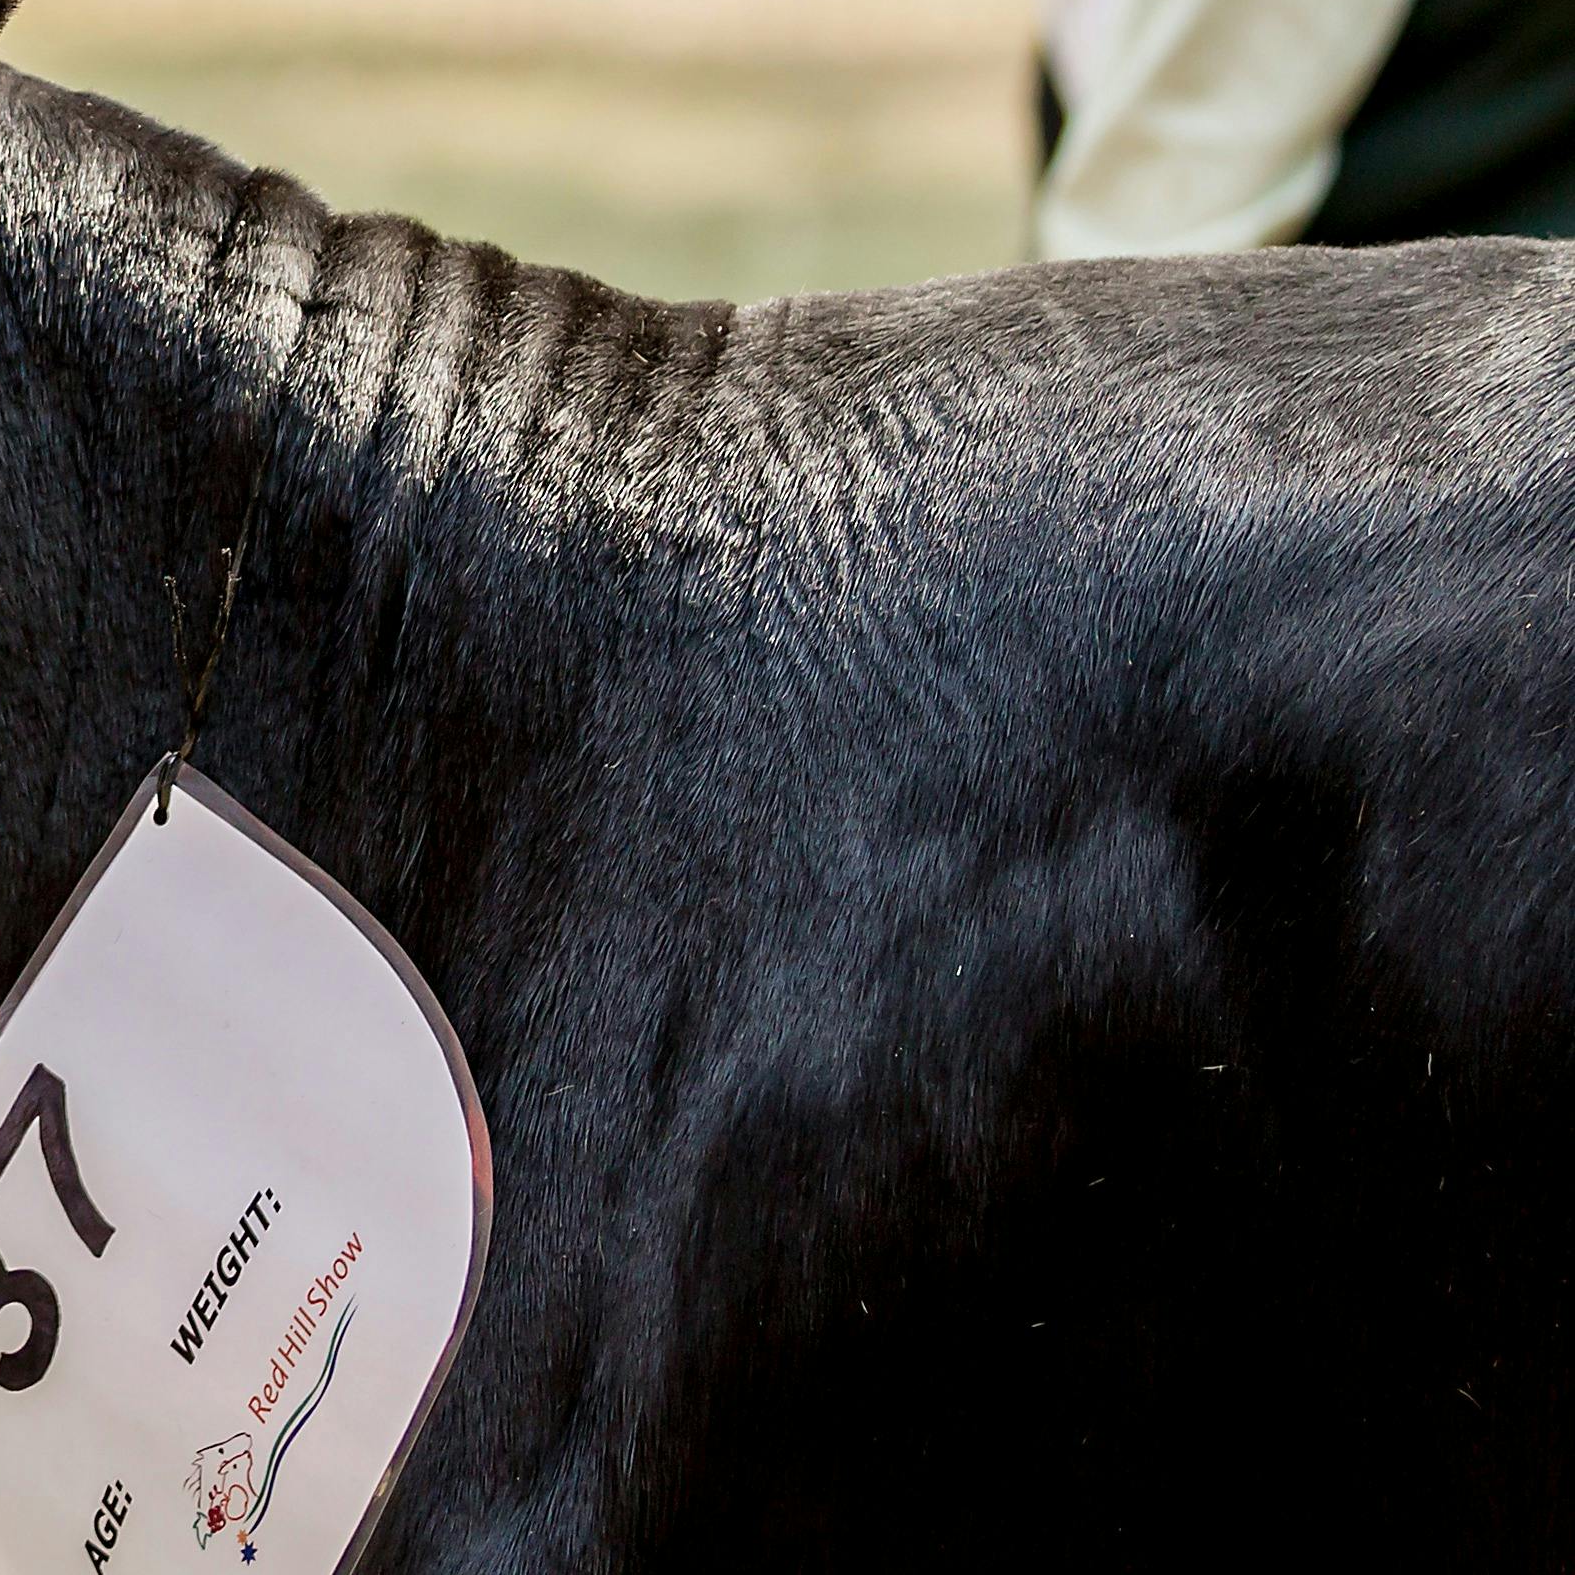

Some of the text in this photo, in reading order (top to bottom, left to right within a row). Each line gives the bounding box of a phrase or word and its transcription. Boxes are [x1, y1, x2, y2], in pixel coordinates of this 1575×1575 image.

[169, 1187, 282, 1365] WEIGHT:
[247, 1231, 364, 1425] Red Hill Show
[84, 1479, 133, 1575] AGE:
